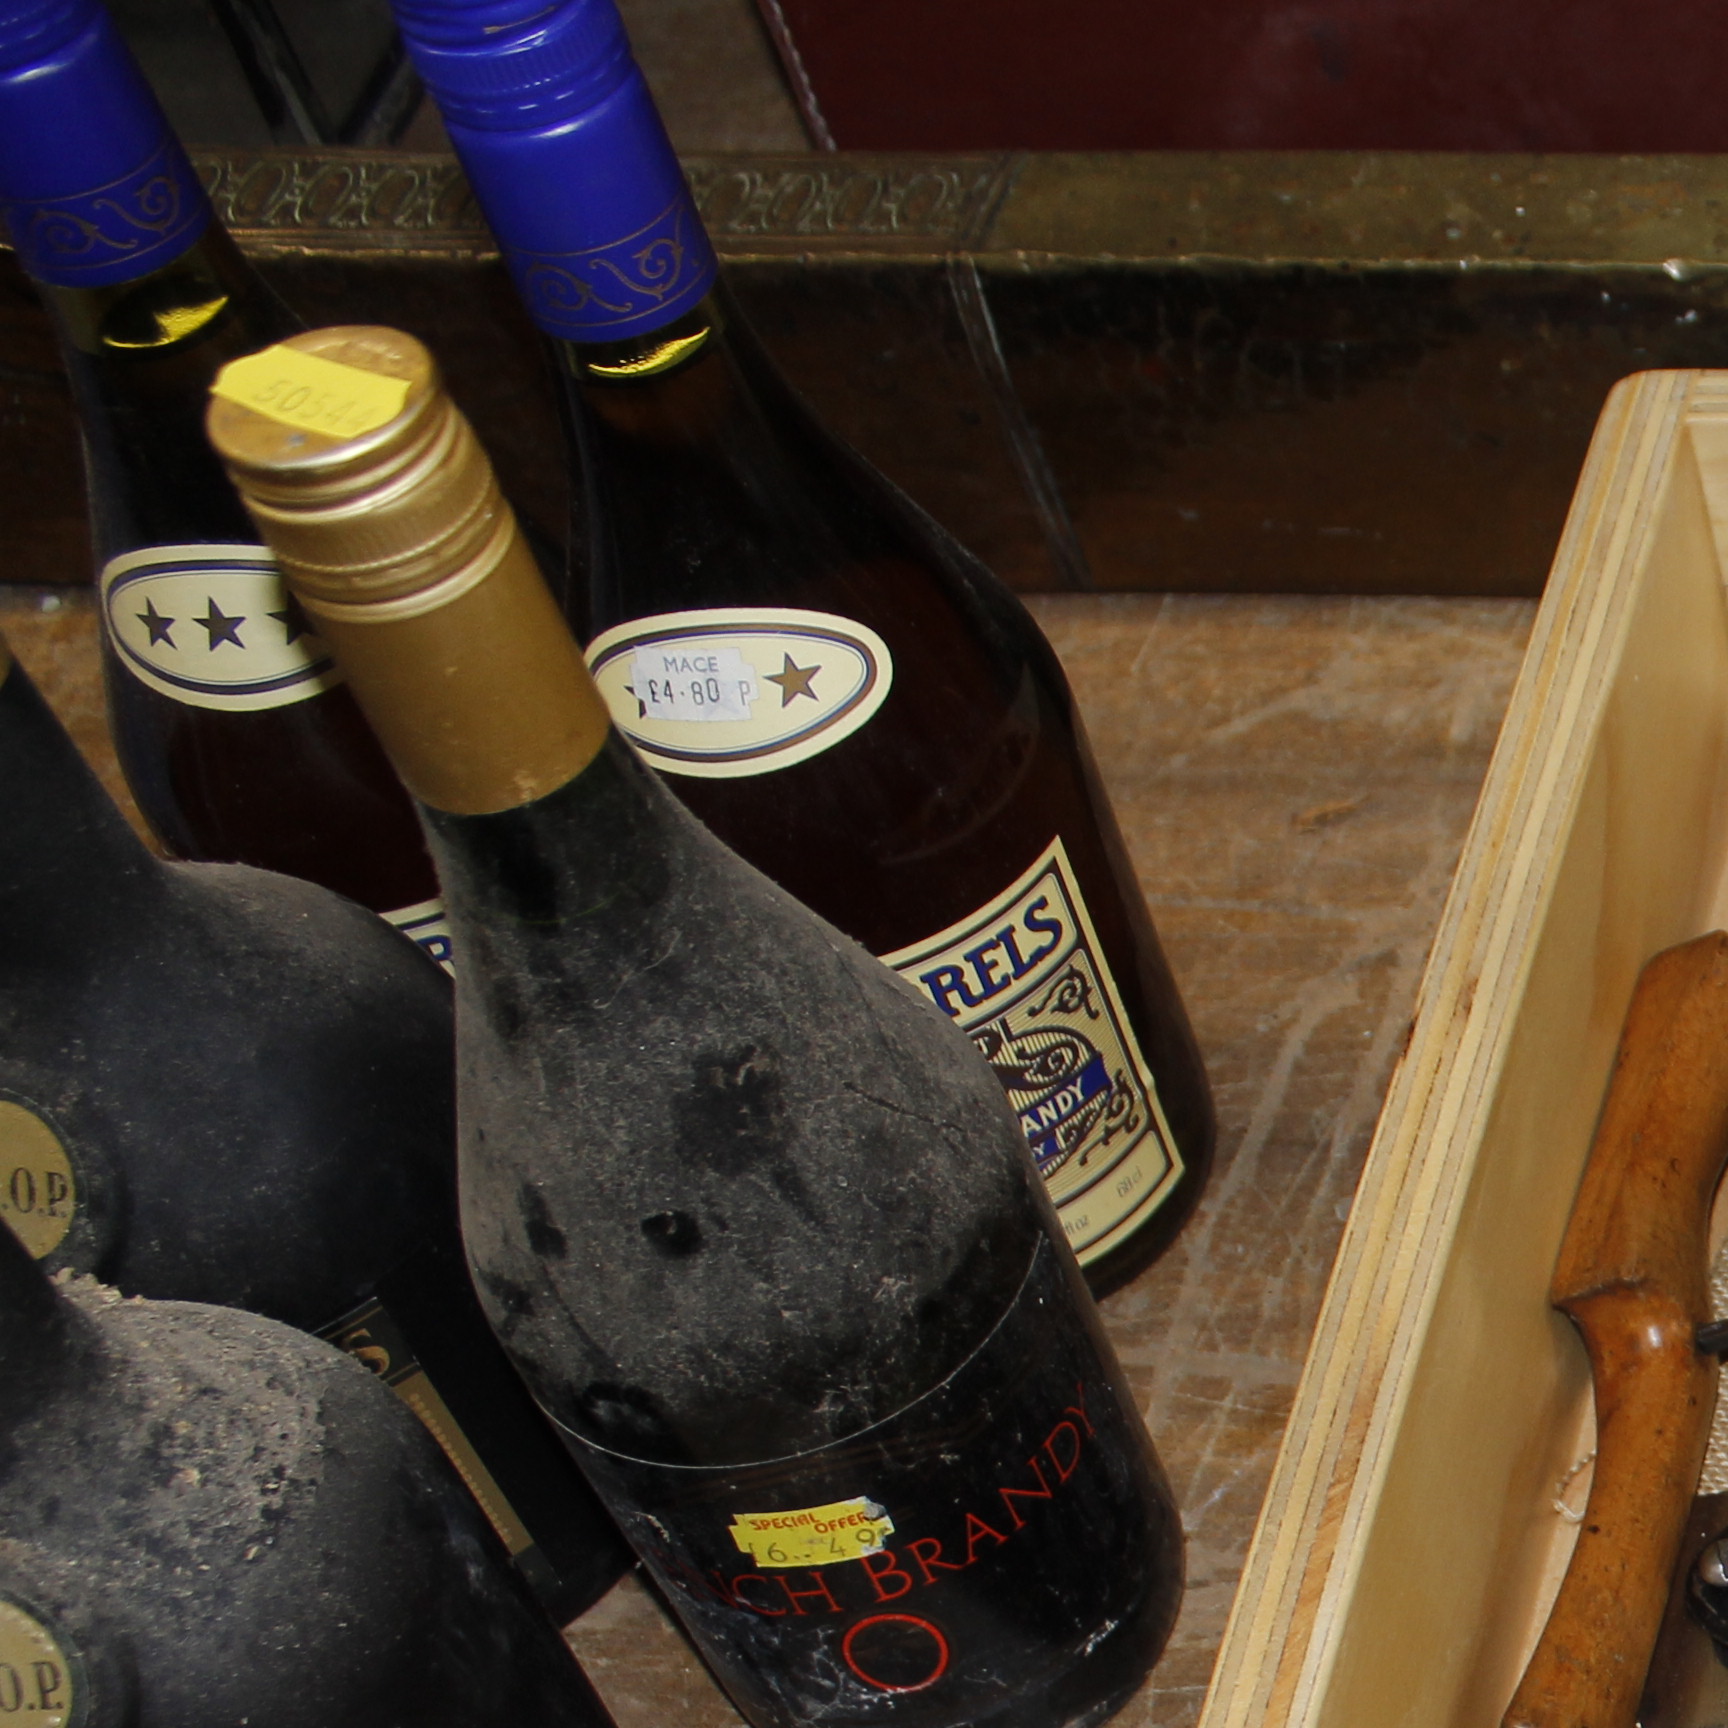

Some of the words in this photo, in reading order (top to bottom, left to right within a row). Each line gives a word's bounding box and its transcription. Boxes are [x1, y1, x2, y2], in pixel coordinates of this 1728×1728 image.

[662, 656, 719, 674] MACE
[920, 895, 1062, 1017] RELS
[1021, 1077, 1085, 1138] ANDY
[749, 1513, 820, 1531] SPECIAL
[859, 1381, 1098, 1602] BRANDY
